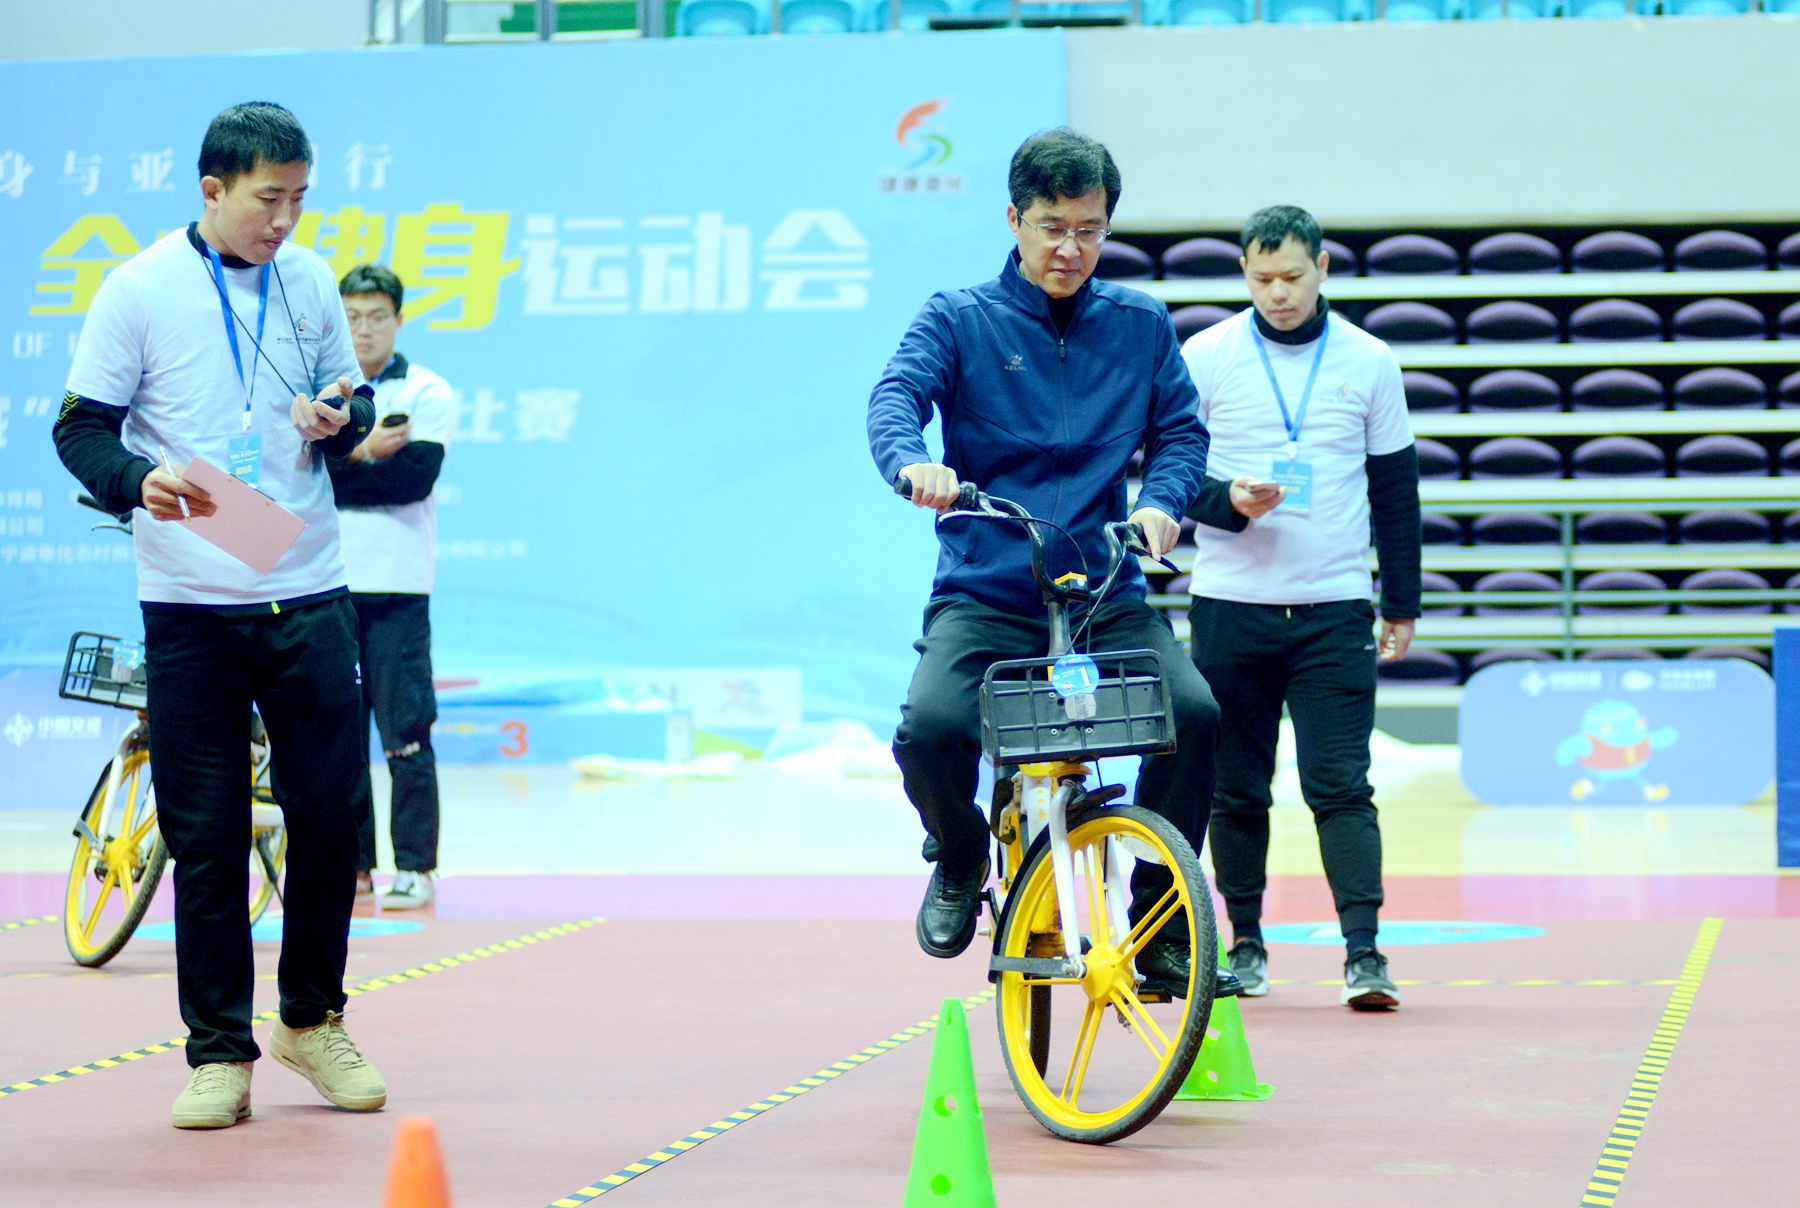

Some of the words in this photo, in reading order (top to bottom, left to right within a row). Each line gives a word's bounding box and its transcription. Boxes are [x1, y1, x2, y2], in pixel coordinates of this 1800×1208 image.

[30, 203, 873, 330] 全健身运动会
[13, 331, 53, 358] OF
[129, 650, 138, 665] 2
[1078, 667, 1092, 687] 1
[500, 720, 528, 758] 3
